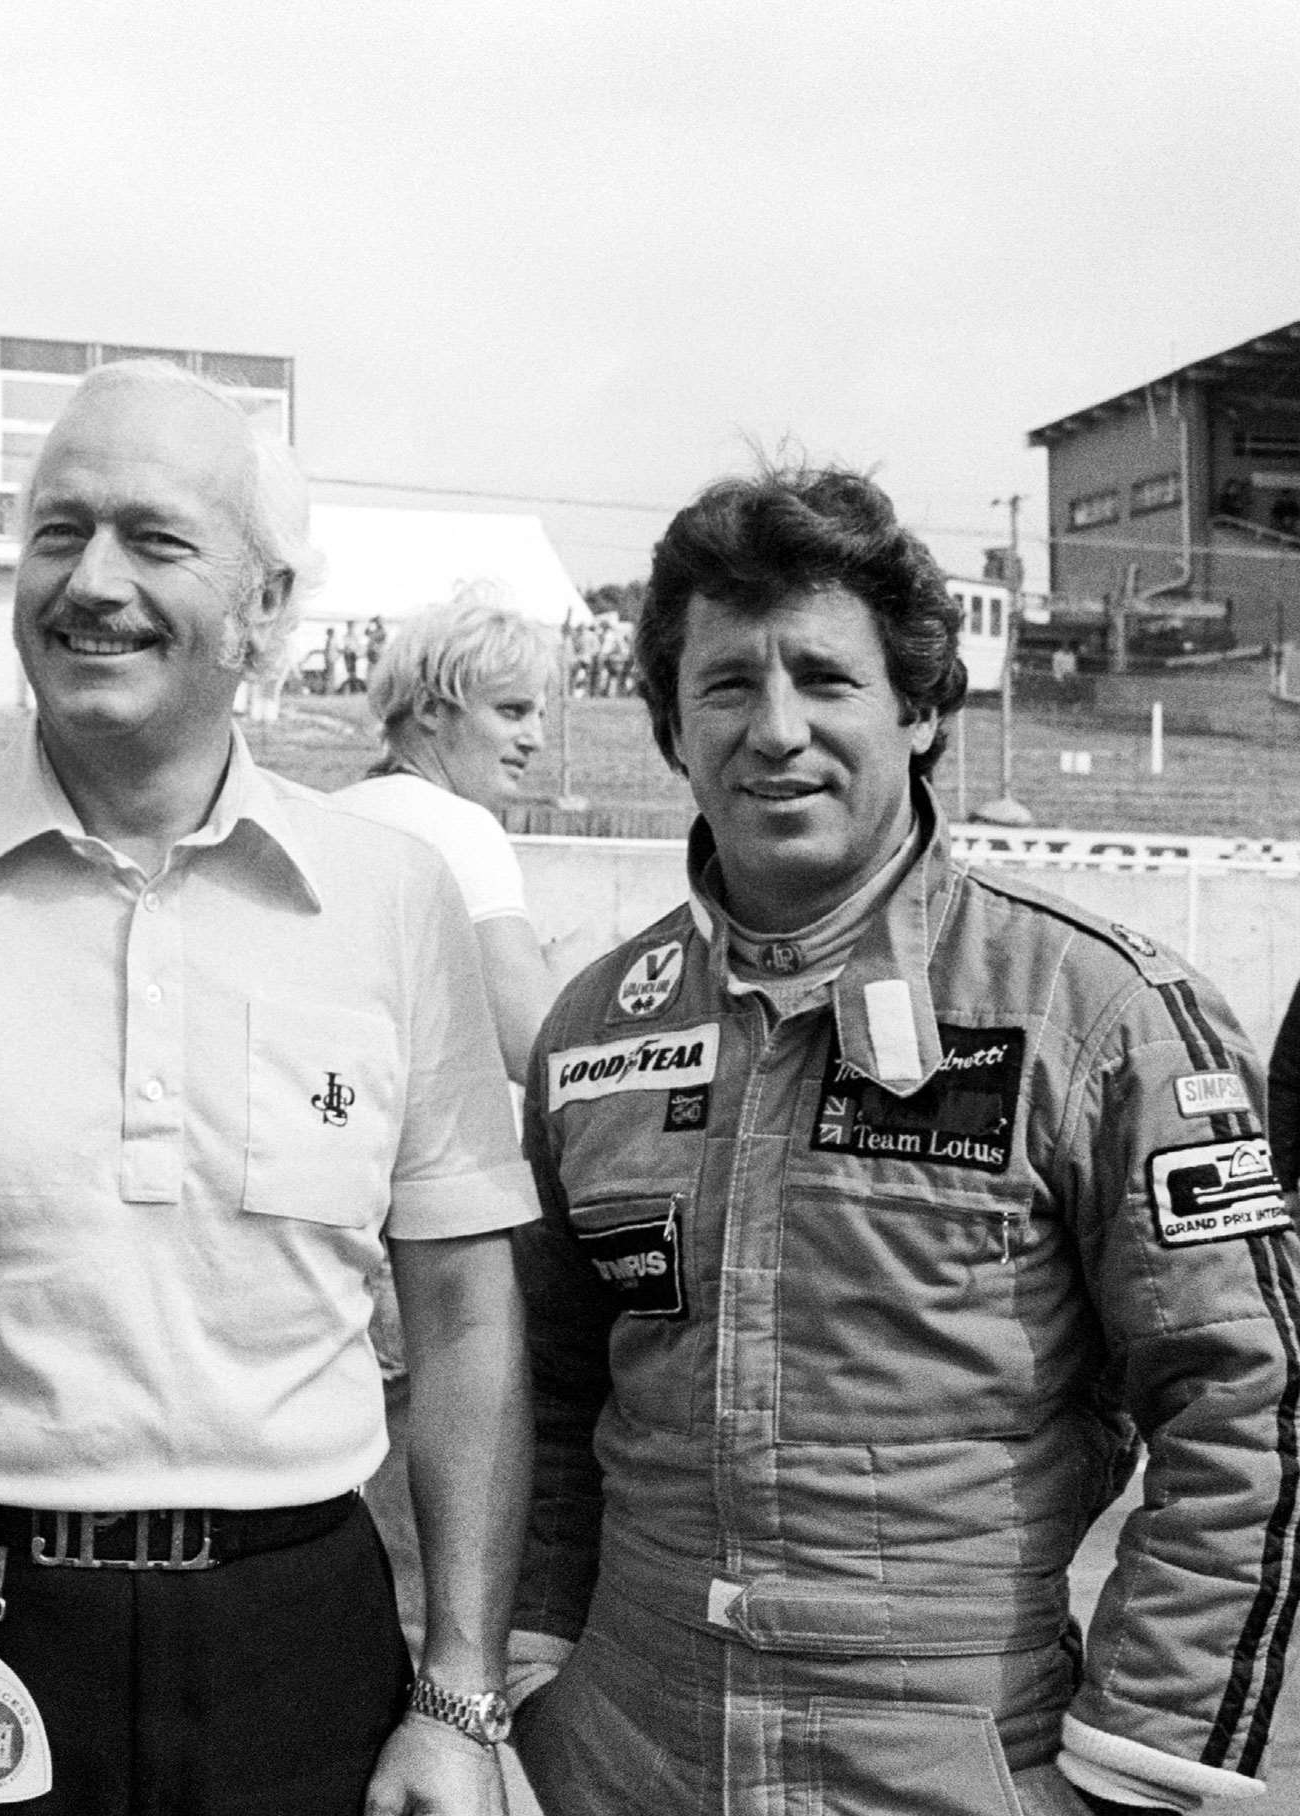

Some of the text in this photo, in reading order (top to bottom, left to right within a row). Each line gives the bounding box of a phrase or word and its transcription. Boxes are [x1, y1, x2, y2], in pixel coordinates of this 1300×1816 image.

[854, 1125, 1004, 1165] Team Lotus
[1165, 1217, 1217, 1237] GRAND
[1223, 1210, 1251, 1226] PRIX
